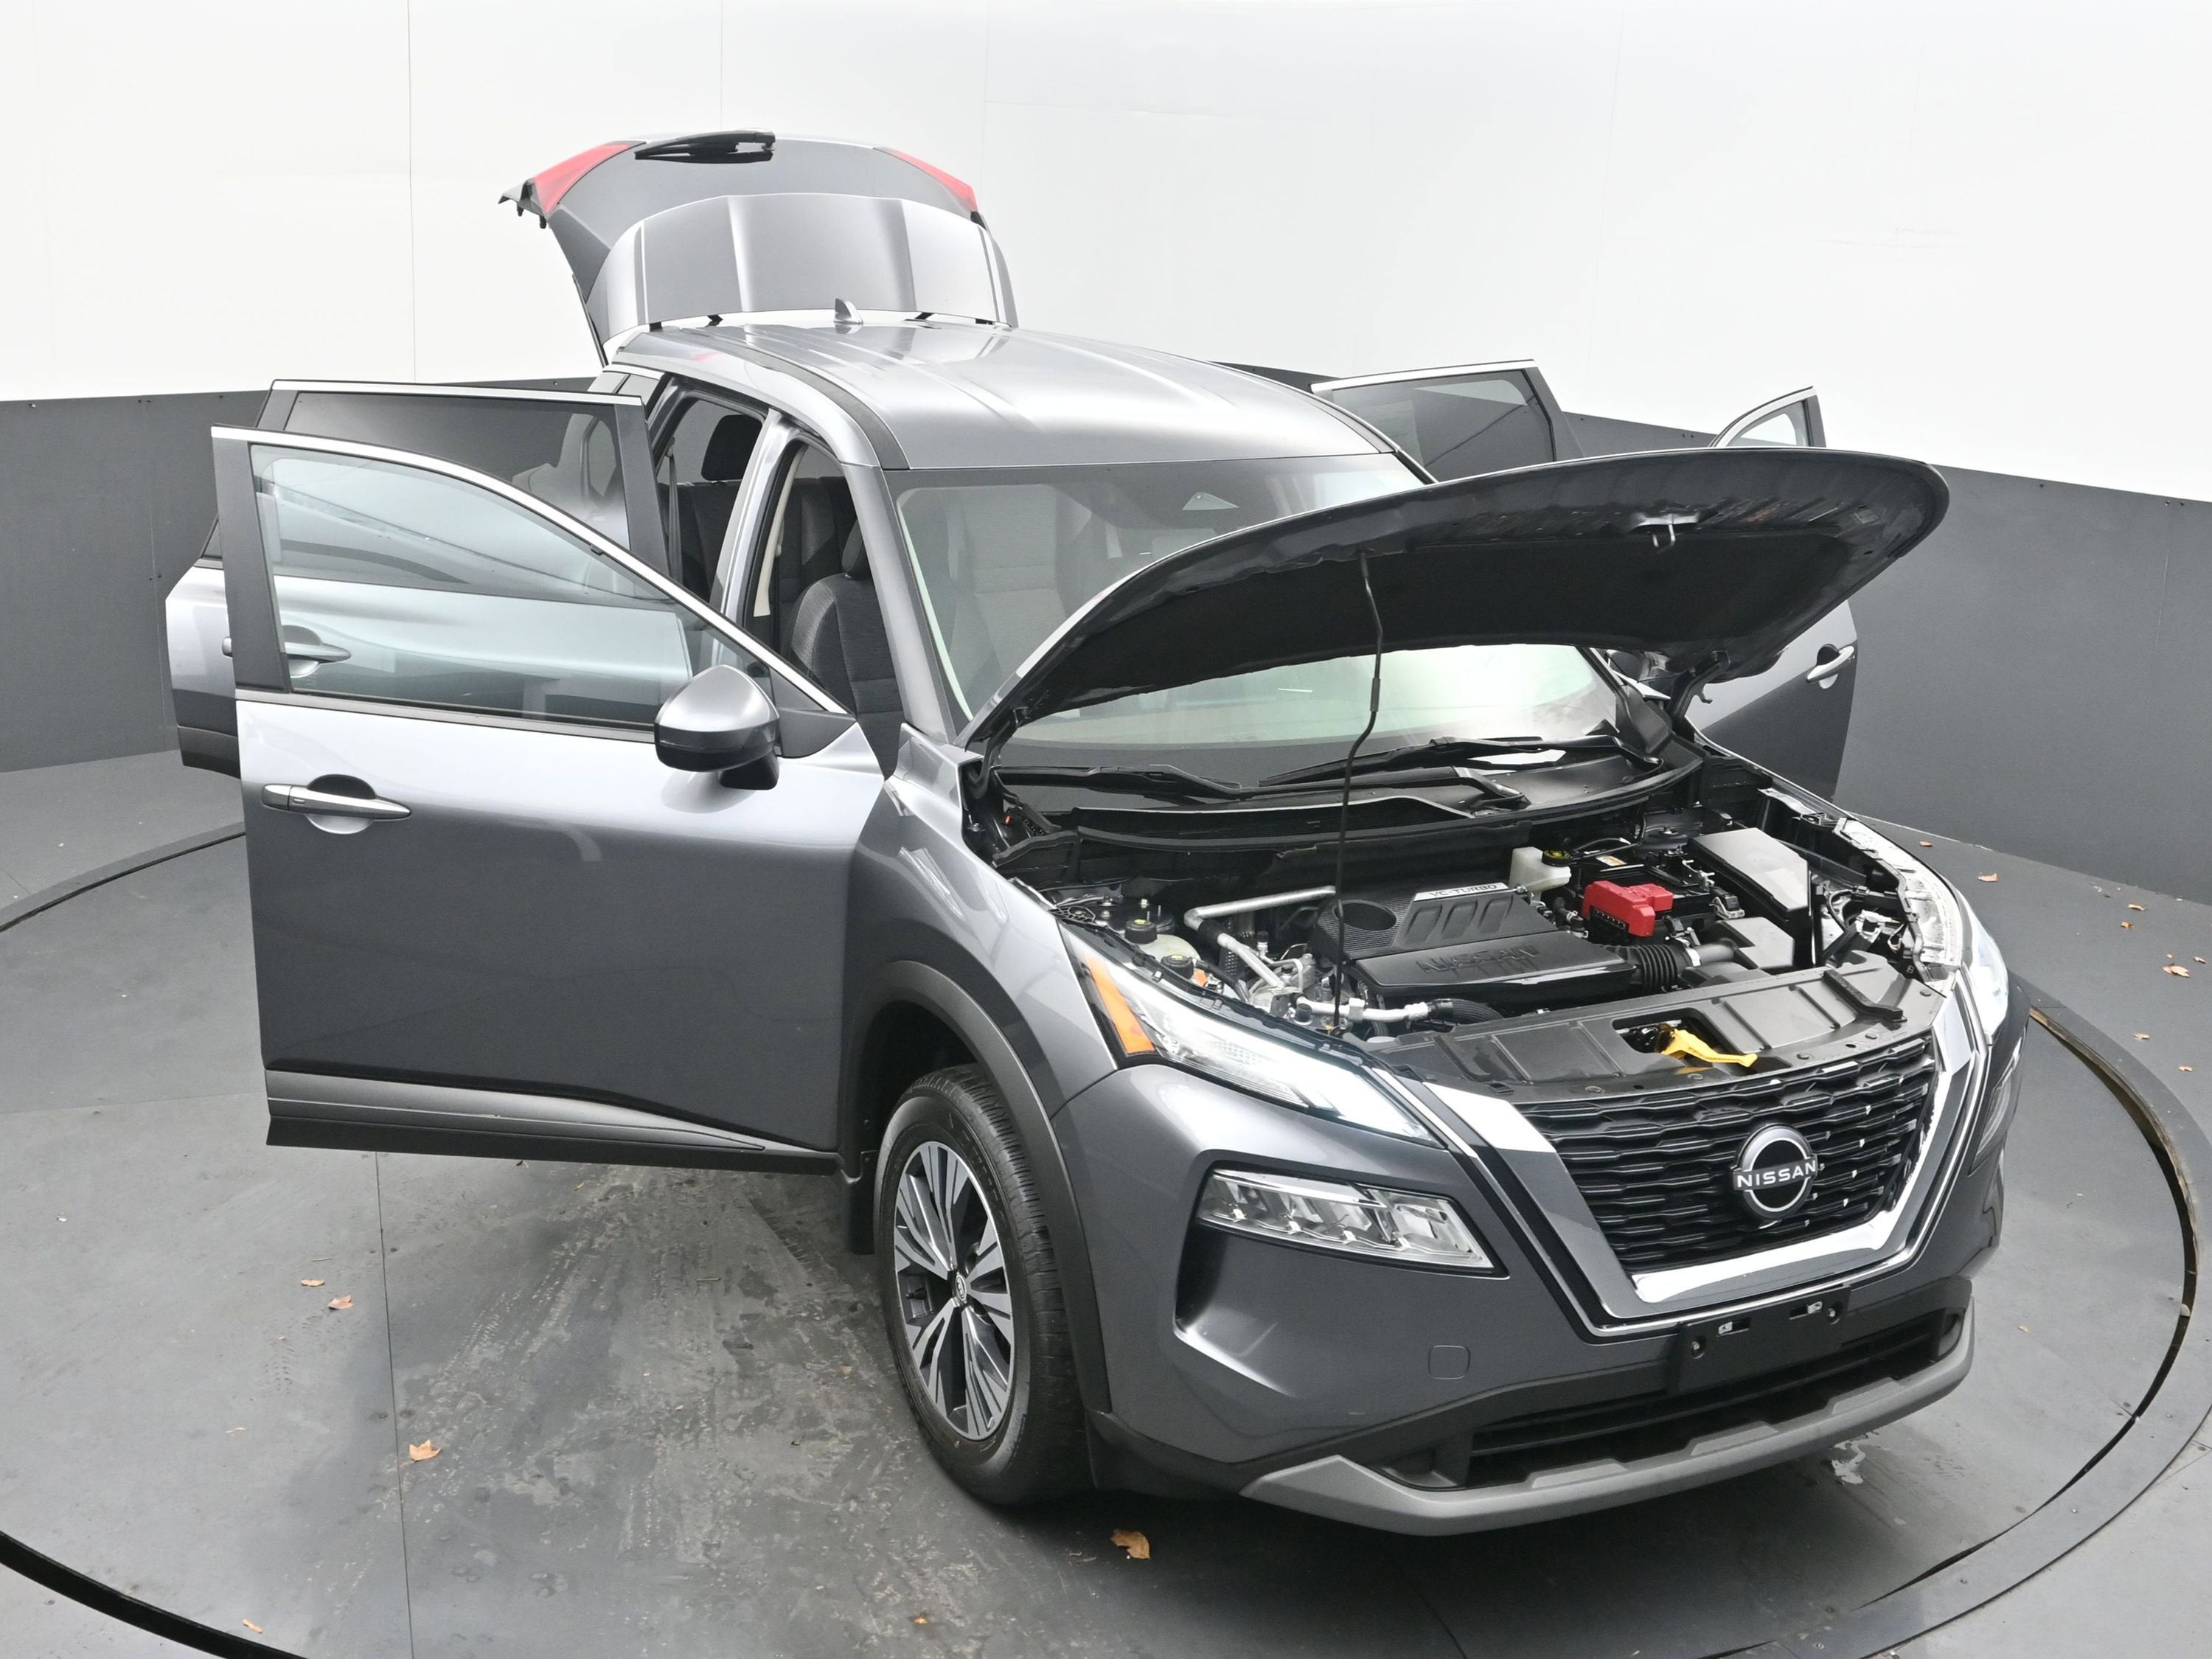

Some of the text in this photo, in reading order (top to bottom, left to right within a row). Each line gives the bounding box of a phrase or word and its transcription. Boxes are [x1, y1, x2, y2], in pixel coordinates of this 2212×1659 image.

[1430, 884, 1498, 897] VC-TURBO
[1416, 945, 1539, 973] NISSAN
[1737, 1160, 1816, 1188] NISSAN
